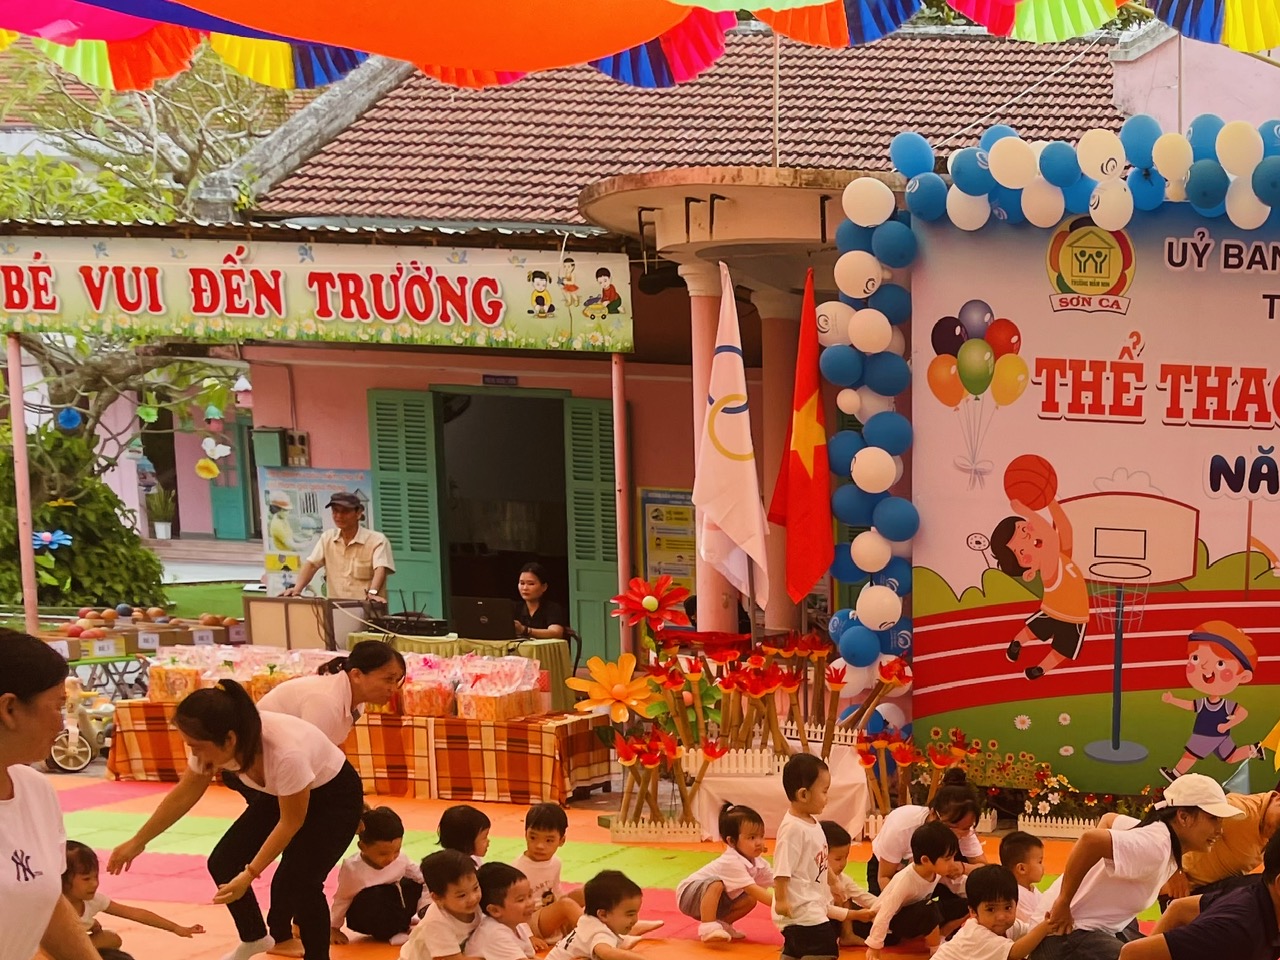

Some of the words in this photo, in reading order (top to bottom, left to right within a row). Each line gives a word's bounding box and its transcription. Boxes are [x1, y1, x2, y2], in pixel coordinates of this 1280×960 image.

[1166, 231, 1211, 268] UỶ
[0, 251, 57, 311] BÉ
[78, 265, 163, 313] VUI
[188, 245, 285, 316] ĐẾN
[308, 260, 503, 325] TRƯỜNG
[1059, 296, 1092, 308] SƠN
[1098, 298, 1122, 310] CA
[1032, 331, 1147, 422] THỂ
